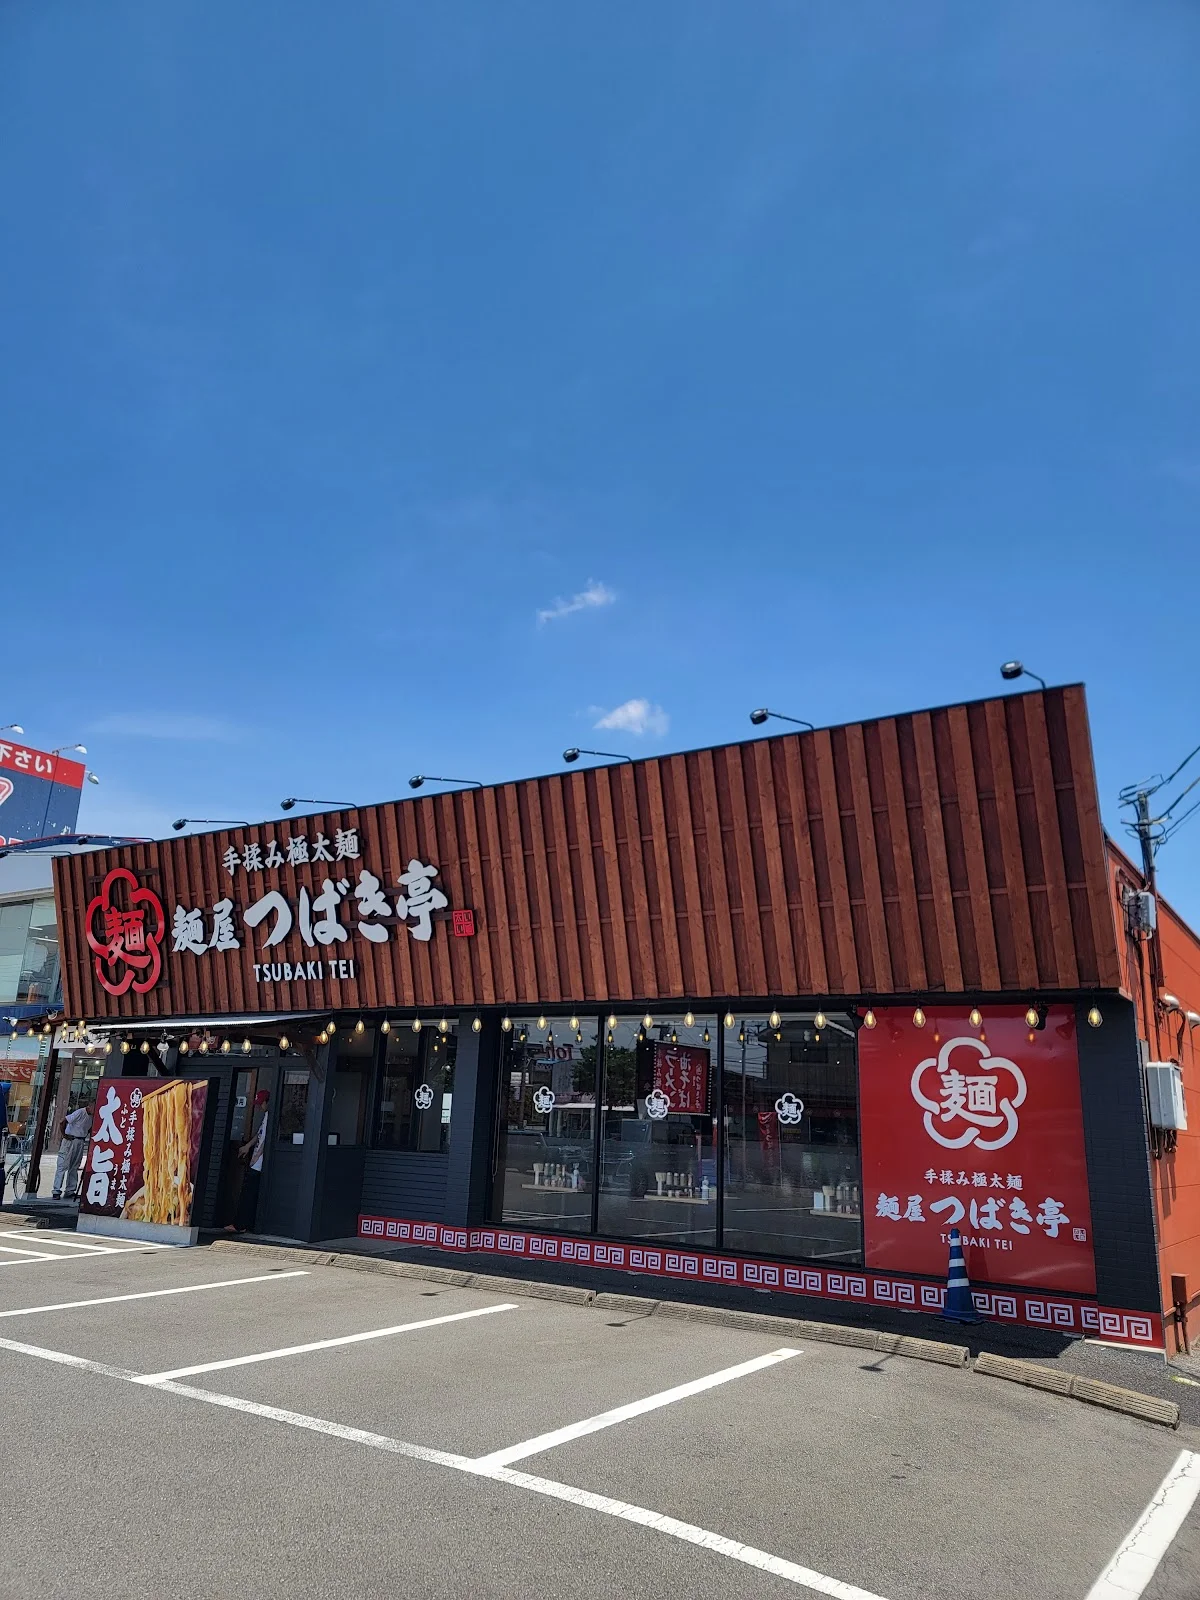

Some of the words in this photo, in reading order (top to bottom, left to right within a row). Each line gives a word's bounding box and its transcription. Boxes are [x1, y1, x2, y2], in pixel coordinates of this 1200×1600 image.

[222, 828, 360, 876] 手揉み極太麺
[105, 906, 151, 968] 麺
[253, 960, 323, 983] TSUBAKI
[329, 959, 355, 979] TEI
[940, 1069, 1004, 1127] 麺
[86, 1086, 124, 1206] 太旨
[924, 1168, 1023, 1191] 手揉み極太麺
[994, 1238, 1013, 1251] TEI
